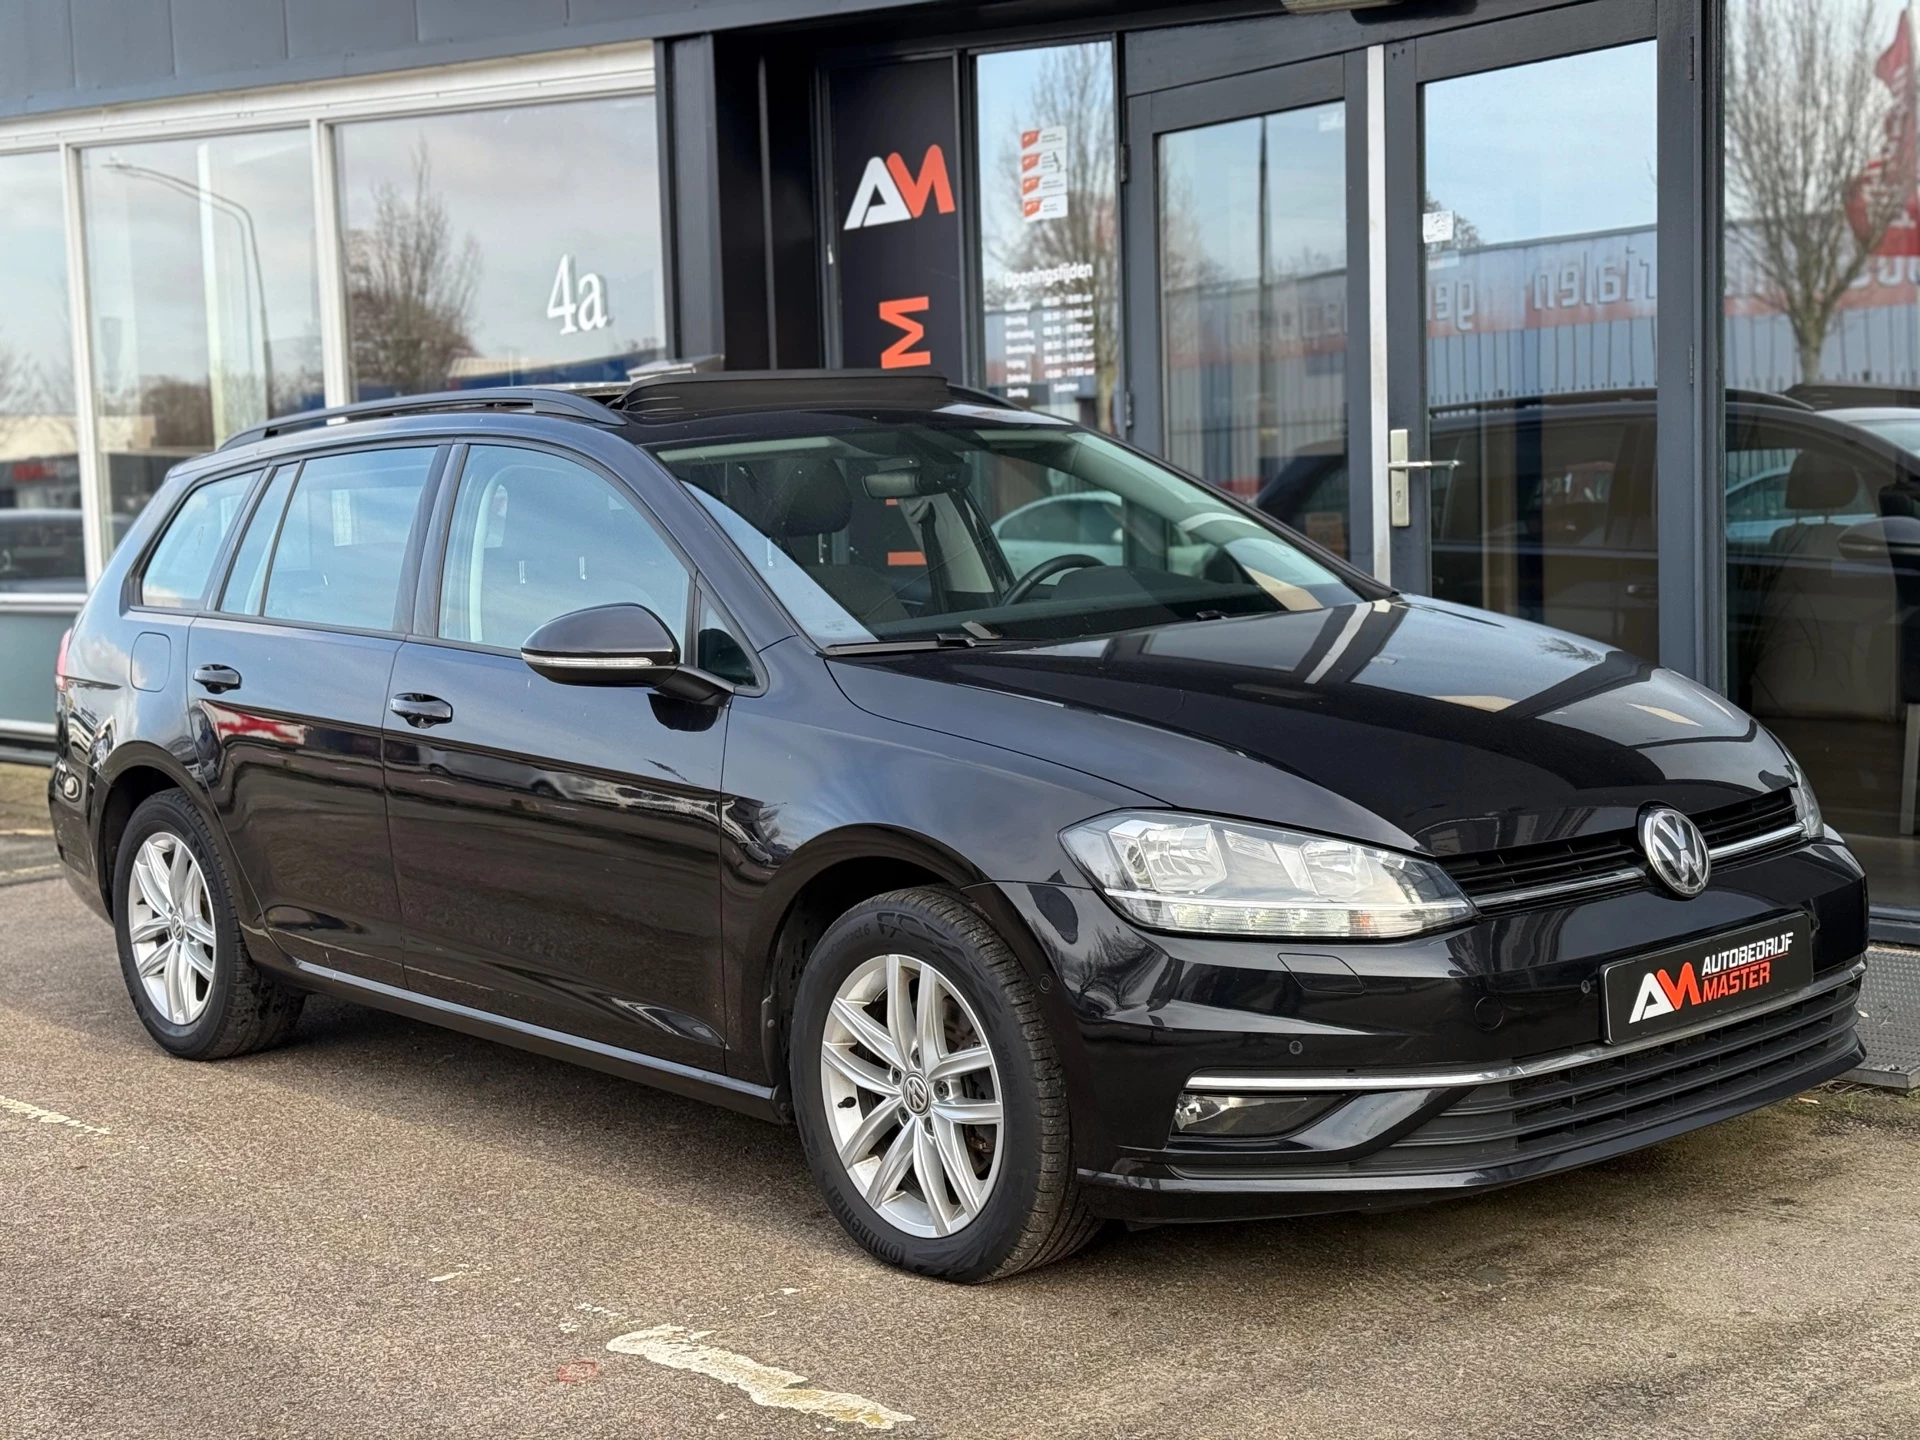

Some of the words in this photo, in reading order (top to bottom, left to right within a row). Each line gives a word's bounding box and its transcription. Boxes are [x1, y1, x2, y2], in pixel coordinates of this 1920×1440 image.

[843, 144, 956, 231] AM
[547, 253, 608, 335] 4a
[1701, 931, 1794, 977] AUTOBEDRIJF
[1702, 961, 1770, 1003] MASTER
[1628, 961, 1702, 1024] AM
